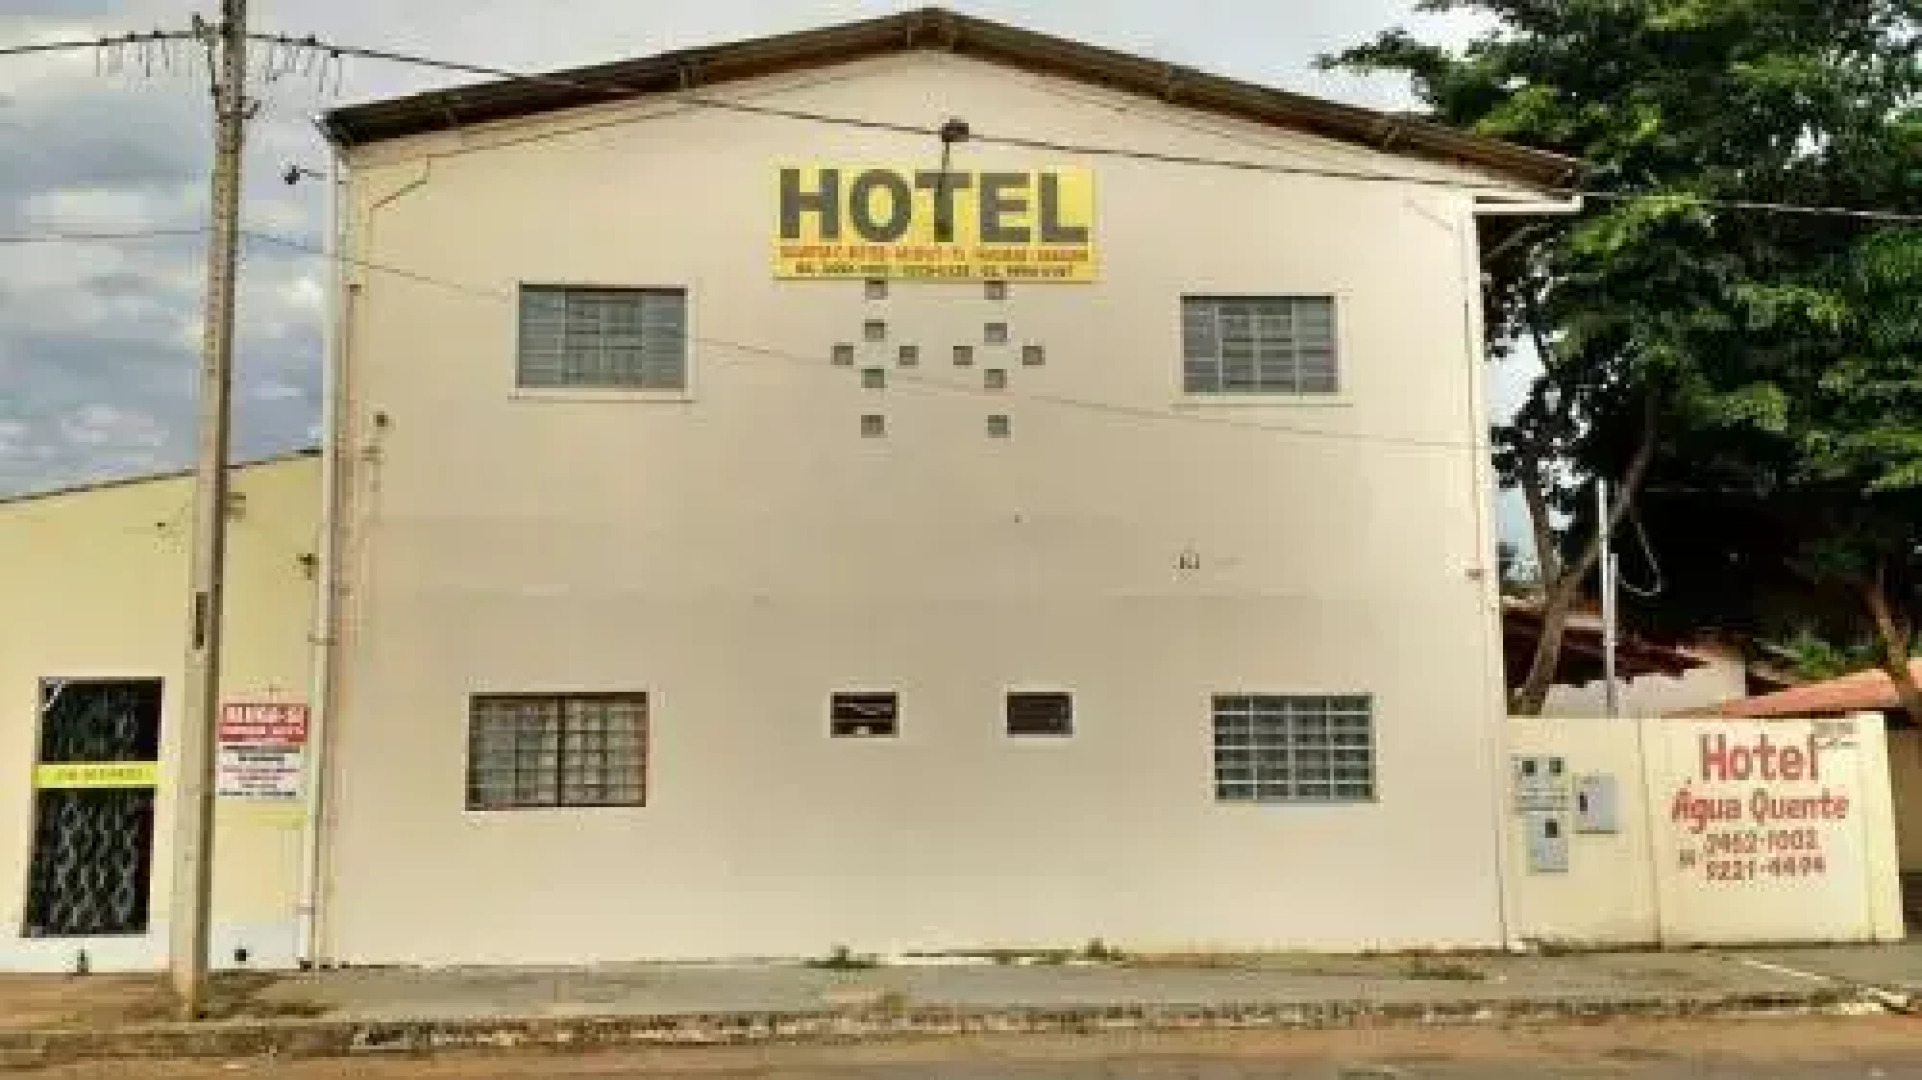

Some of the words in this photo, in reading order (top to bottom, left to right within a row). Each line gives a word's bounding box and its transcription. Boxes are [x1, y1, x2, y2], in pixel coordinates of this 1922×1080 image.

[780, 168, 1089, 243] HOTEL
[1701, 733, 1818, 782] Hotel
[1671, 776, 1742, 834] Água
[1750, 787, 1849, 826] Quente
